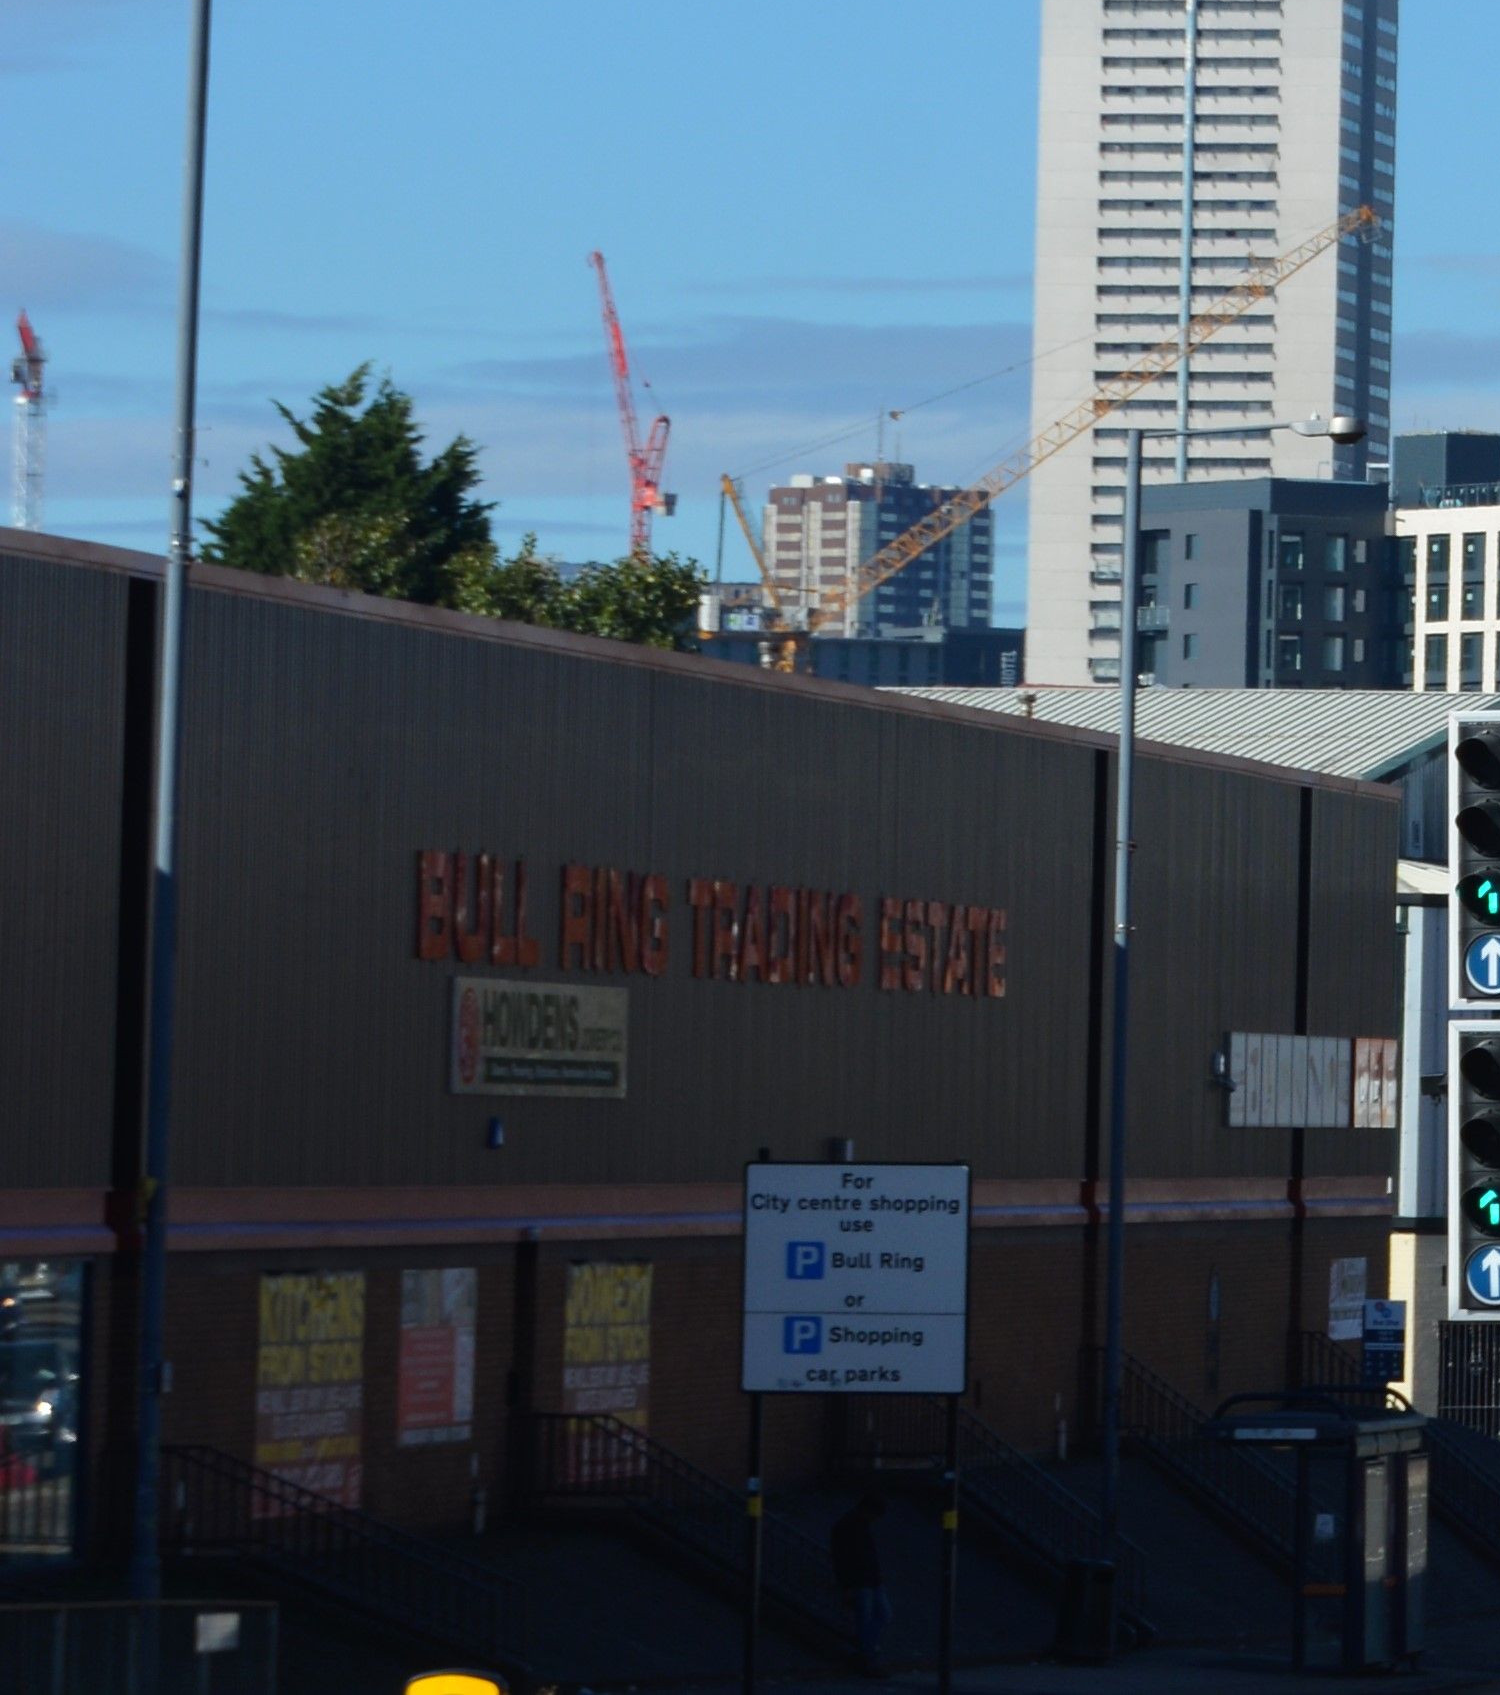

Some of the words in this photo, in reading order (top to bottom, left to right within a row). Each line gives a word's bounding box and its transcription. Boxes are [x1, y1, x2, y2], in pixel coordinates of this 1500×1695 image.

[416, 849, 540, 968] BULL
[560, 860, 670, 977] RING
[687, 876, 862, 988] TRADING
[878, 896, 1009, 998] ESTATE
[482, 989, 580, 1051] HOWDENS
[841, 1173, 875, 1189] For
[750, 1193, 791, 1214] City
[798, 1195, 862, 1211] centre
[869, 1195, 960, 1214] shopping
[839, 1219, 875, 1232] use
[795, 1246, 819, 1277] P
[832, 1252, 872, 1269] Bull
[880, 1252, 925, 1272] Ring
[844, 1294, 865, 1308] or
[793, 1320, 818, 1351] P
[828, 1327, 924, 1346] Shopping
[805, 1367, 838, 1383] car
[844, 1366, 901, 1384] parks
